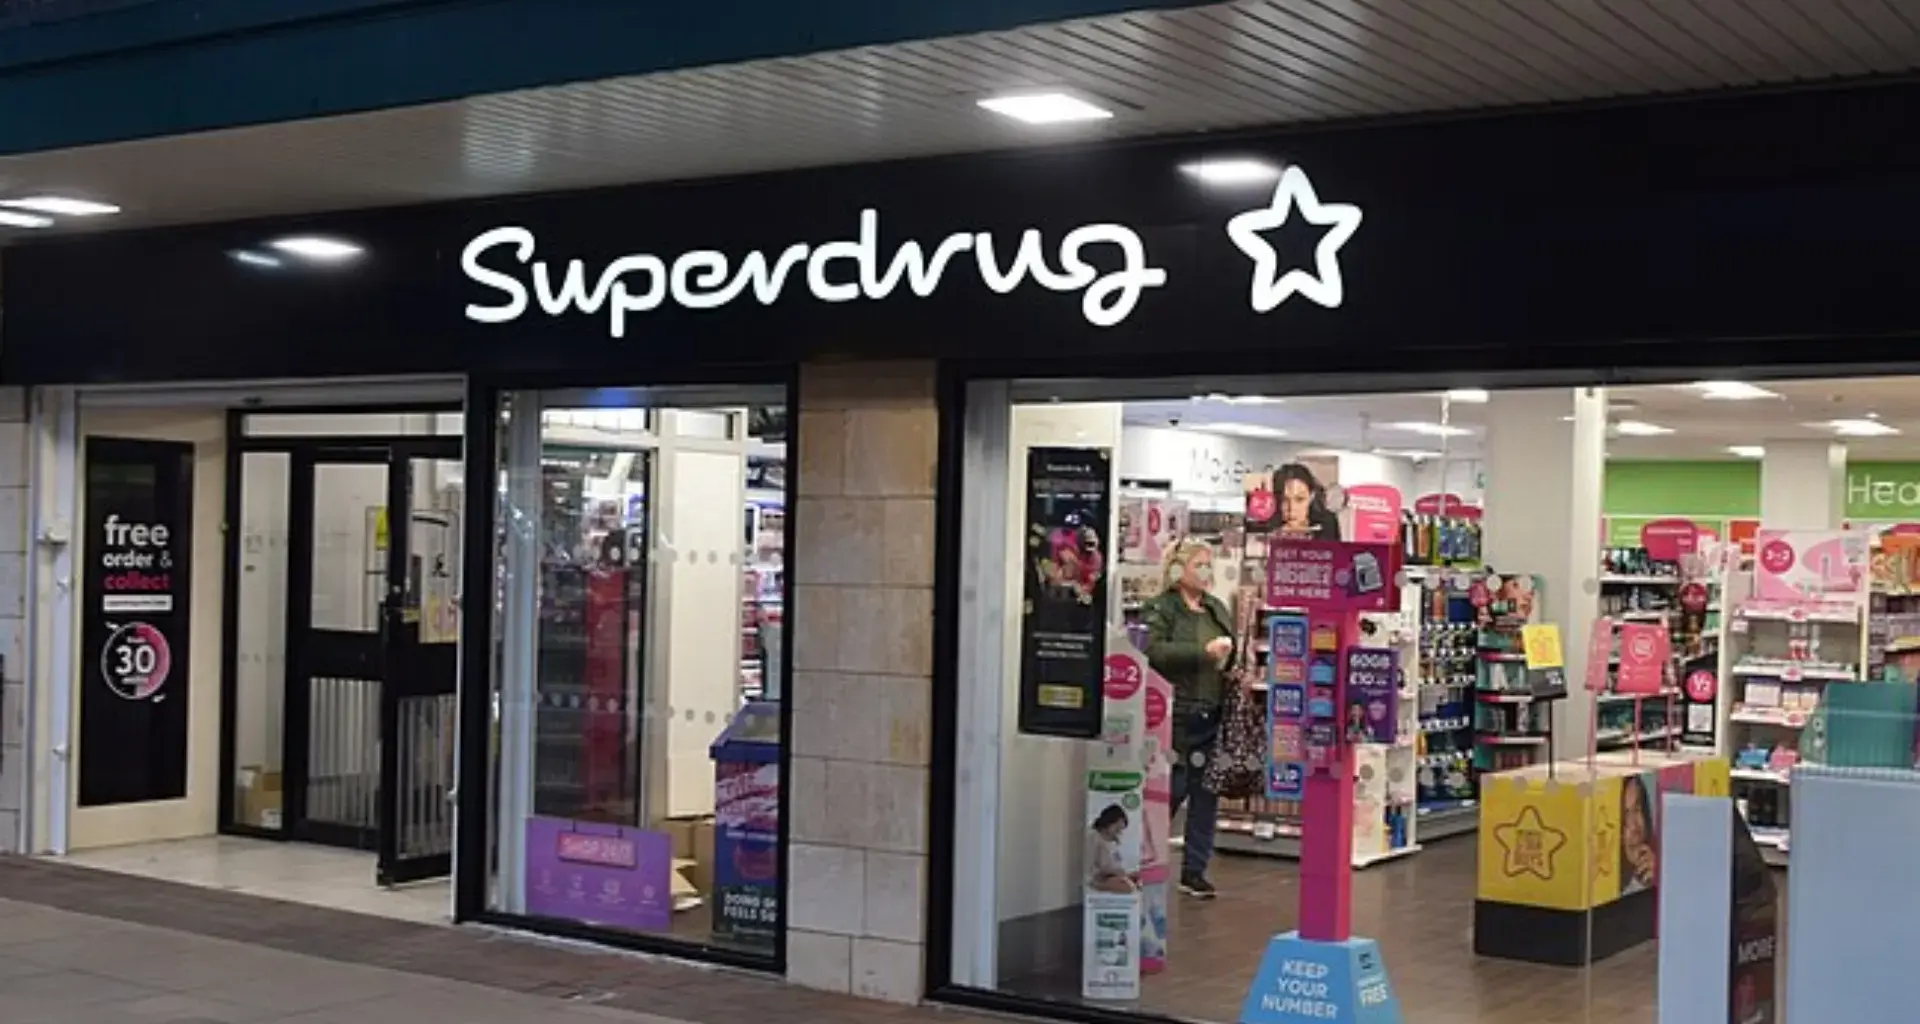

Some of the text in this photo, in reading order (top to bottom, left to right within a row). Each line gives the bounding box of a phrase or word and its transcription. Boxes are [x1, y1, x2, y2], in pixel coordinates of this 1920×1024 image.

[461, 209, 1166, 338] Superdrug
[1848, 474, 1920, 505] Hea
[103, 514, 170, 547] free
[103, 549, 173, 568] order &
[1301, 550, 1333, 561] YOUR
[104, 571, 170, 590] collect
[115, 645, 155, 675] 30
[1126, 665, 1138, 682] 2
[1737, 936, 1773, 963] MORE
[1281, 959, 1329, 979] KEEP
[1277, 977, 1328, 999] YOUR
[1260, 994, 1338, 1020] NUMBER
